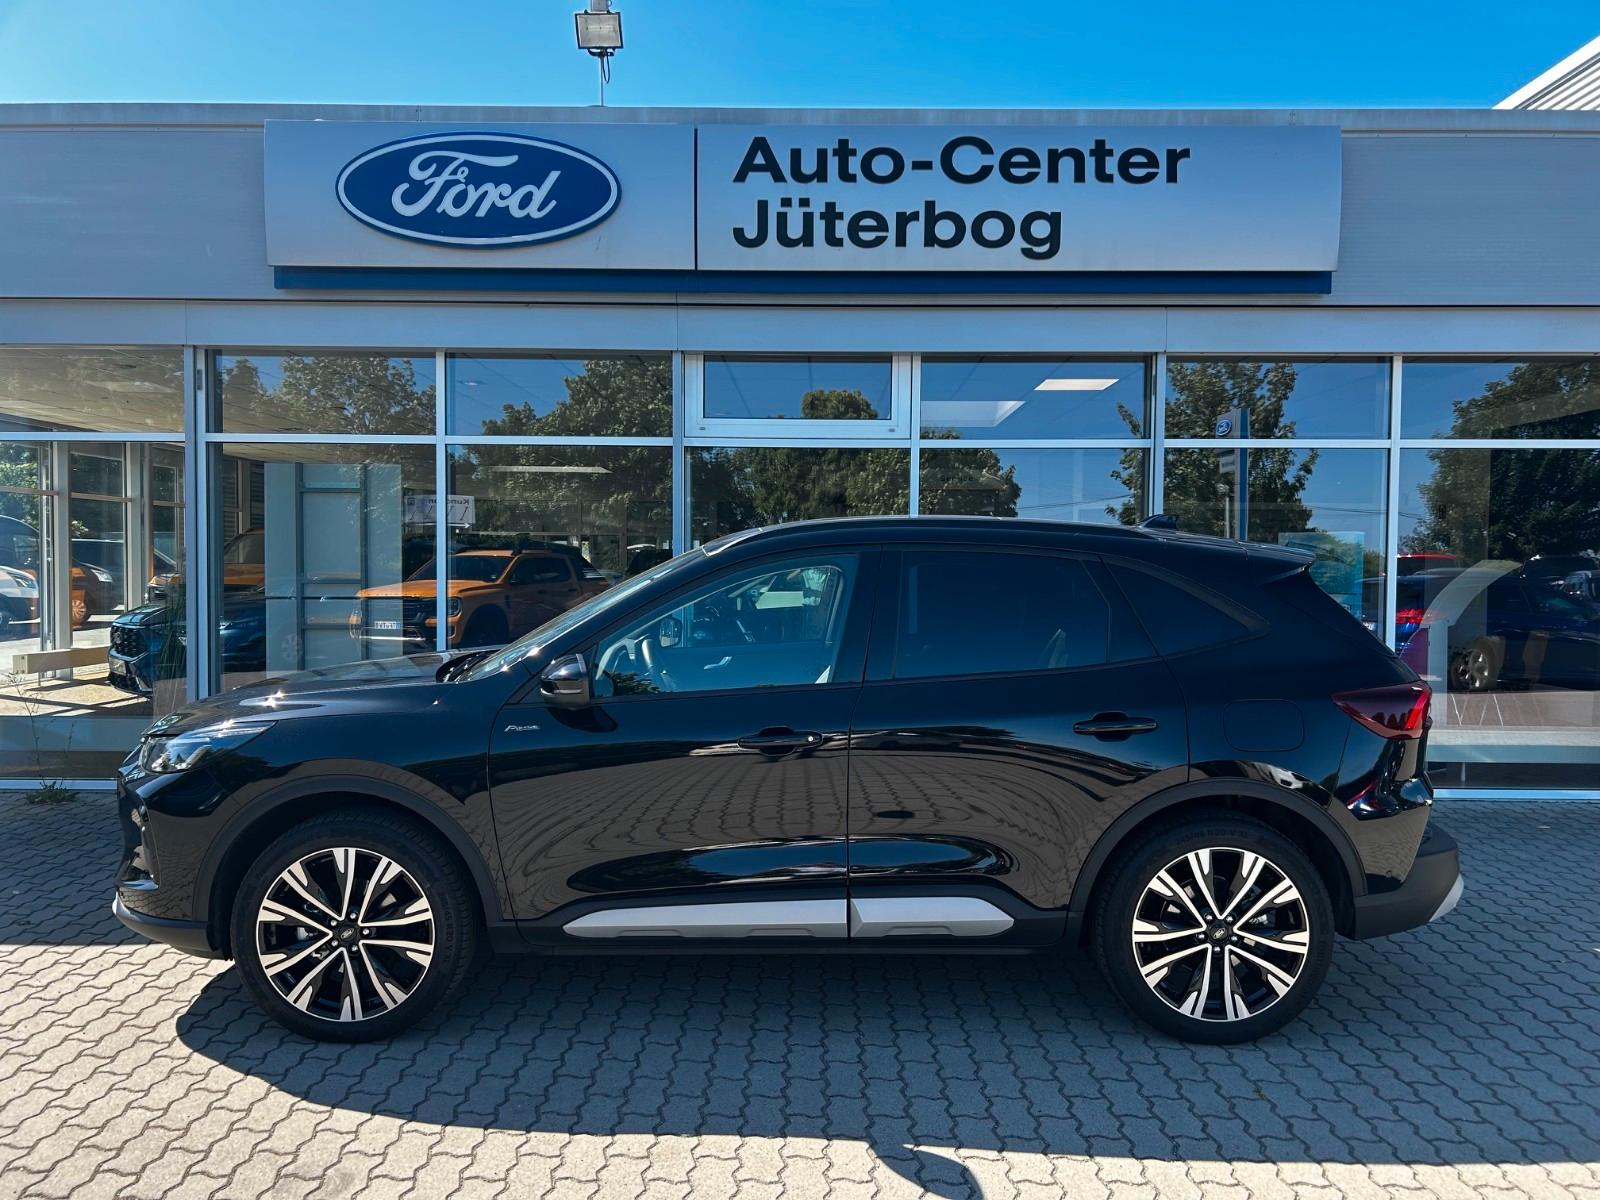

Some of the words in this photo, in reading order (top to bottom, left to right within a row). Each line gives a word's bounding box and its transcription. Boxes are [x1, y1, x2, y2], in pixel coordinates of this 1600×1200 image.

[391, 150, 561, 219] Ford
[733, 135, 1191, 185] Auto-Center
[732, 197, 1062, 260] Jüterbog
